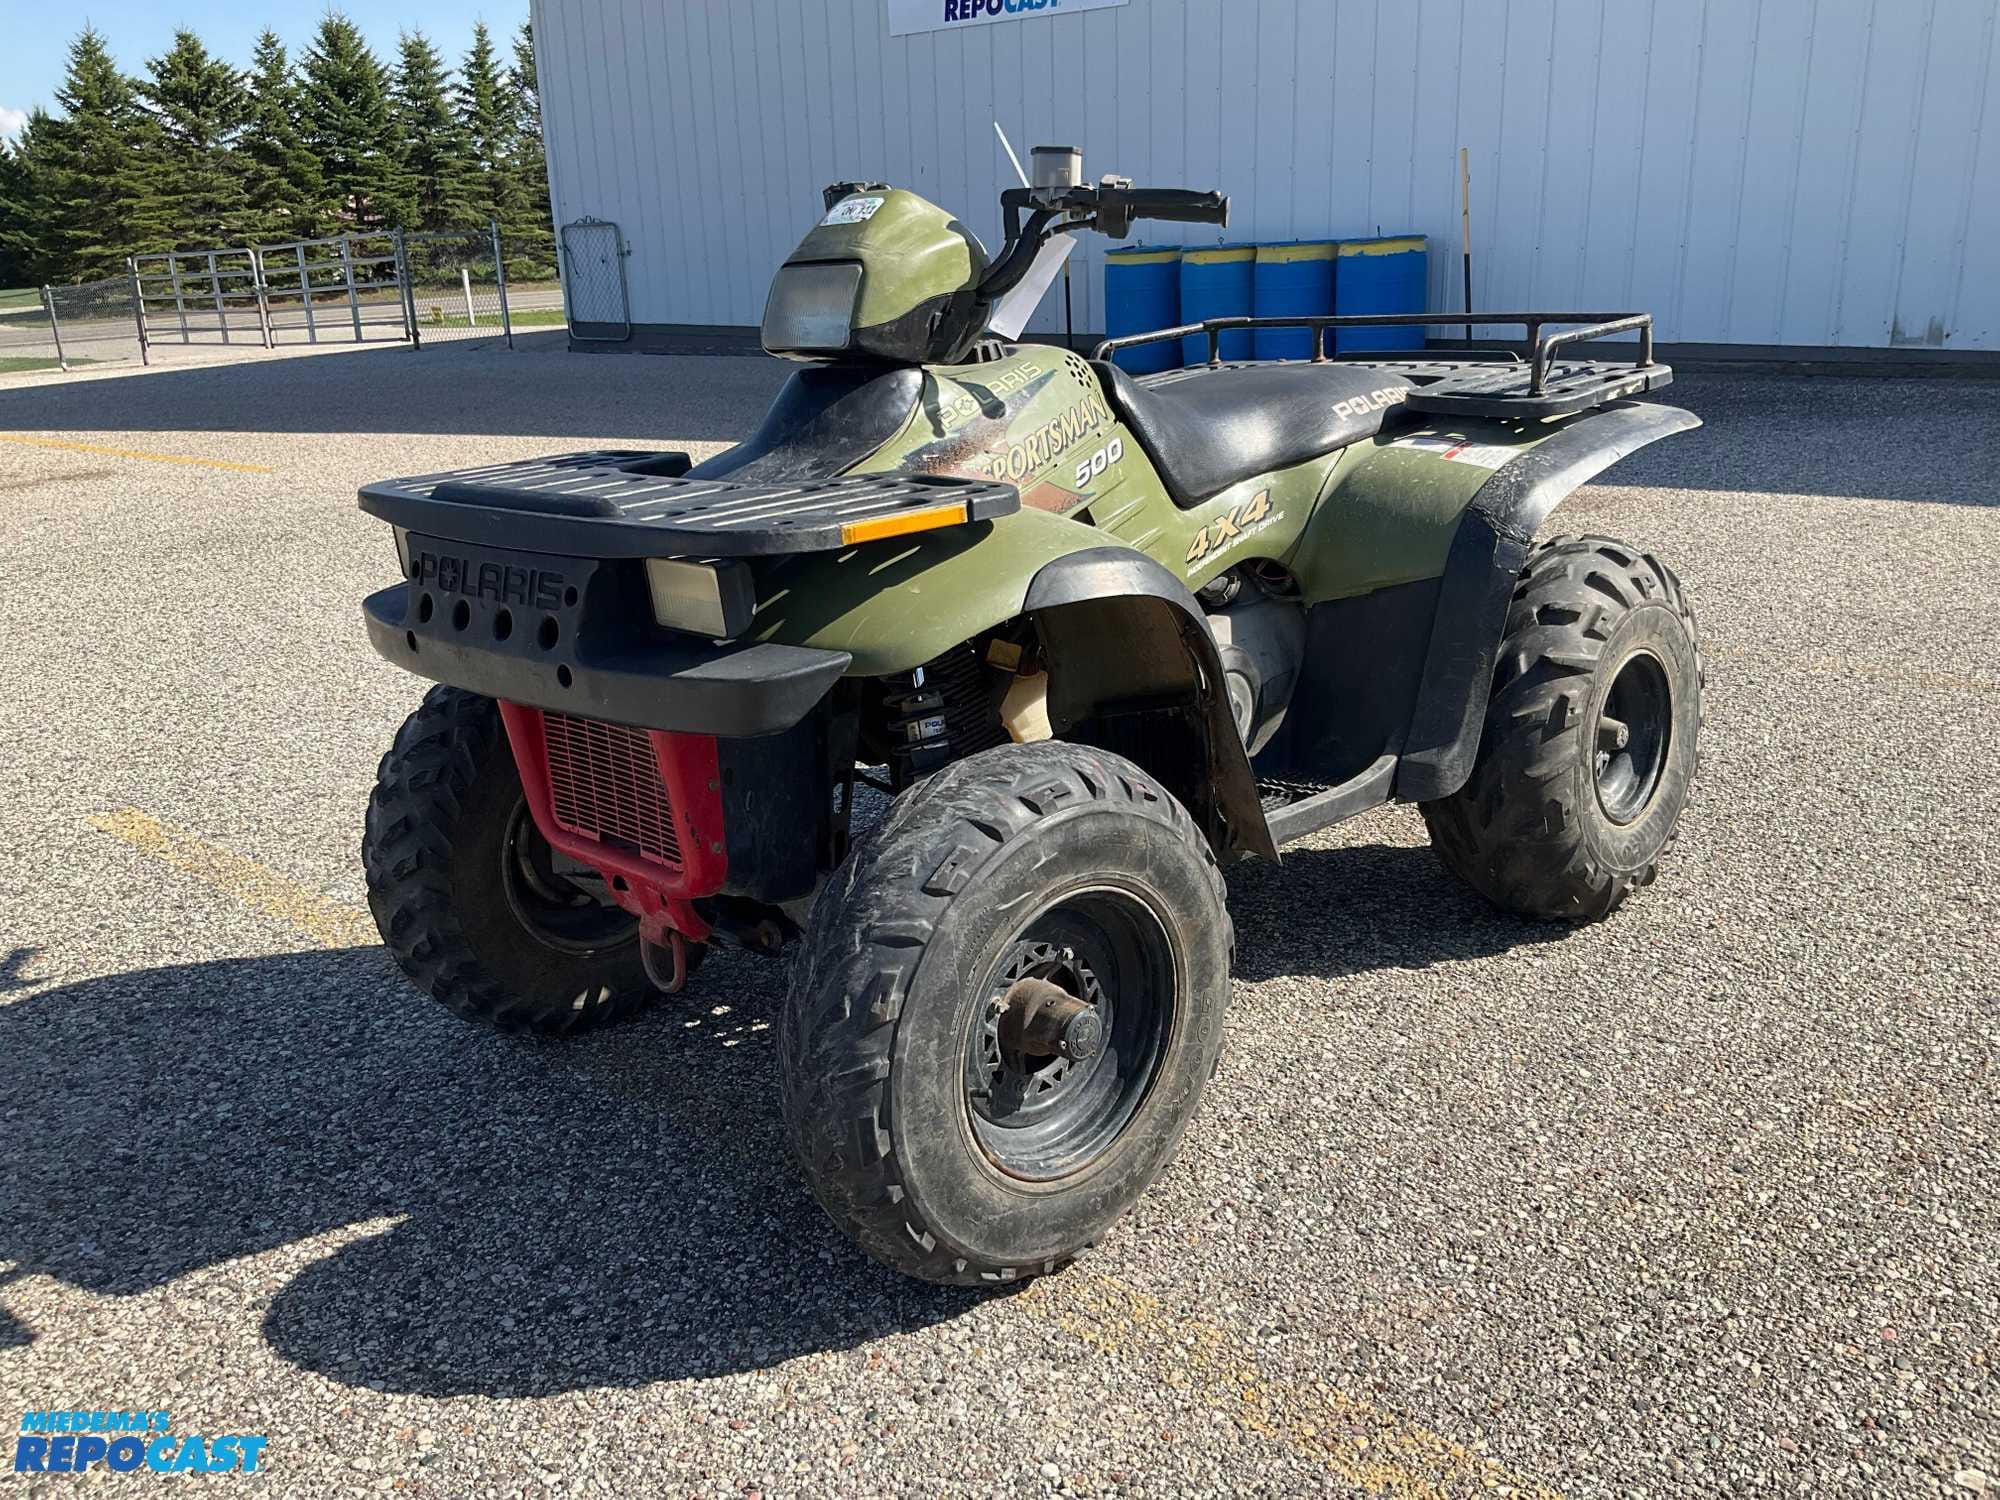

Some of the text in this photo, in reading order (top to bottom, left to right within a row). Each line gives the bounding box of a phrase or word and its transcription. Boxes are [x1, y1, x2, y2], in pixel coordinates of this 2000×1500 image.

[937, 361, 1042, 430] POLARIS
[1075, 437, 1125, 488] 500
[1258, 510, 1286, 532] DRIVE
[419, 551, 565, 611] POLARIS
